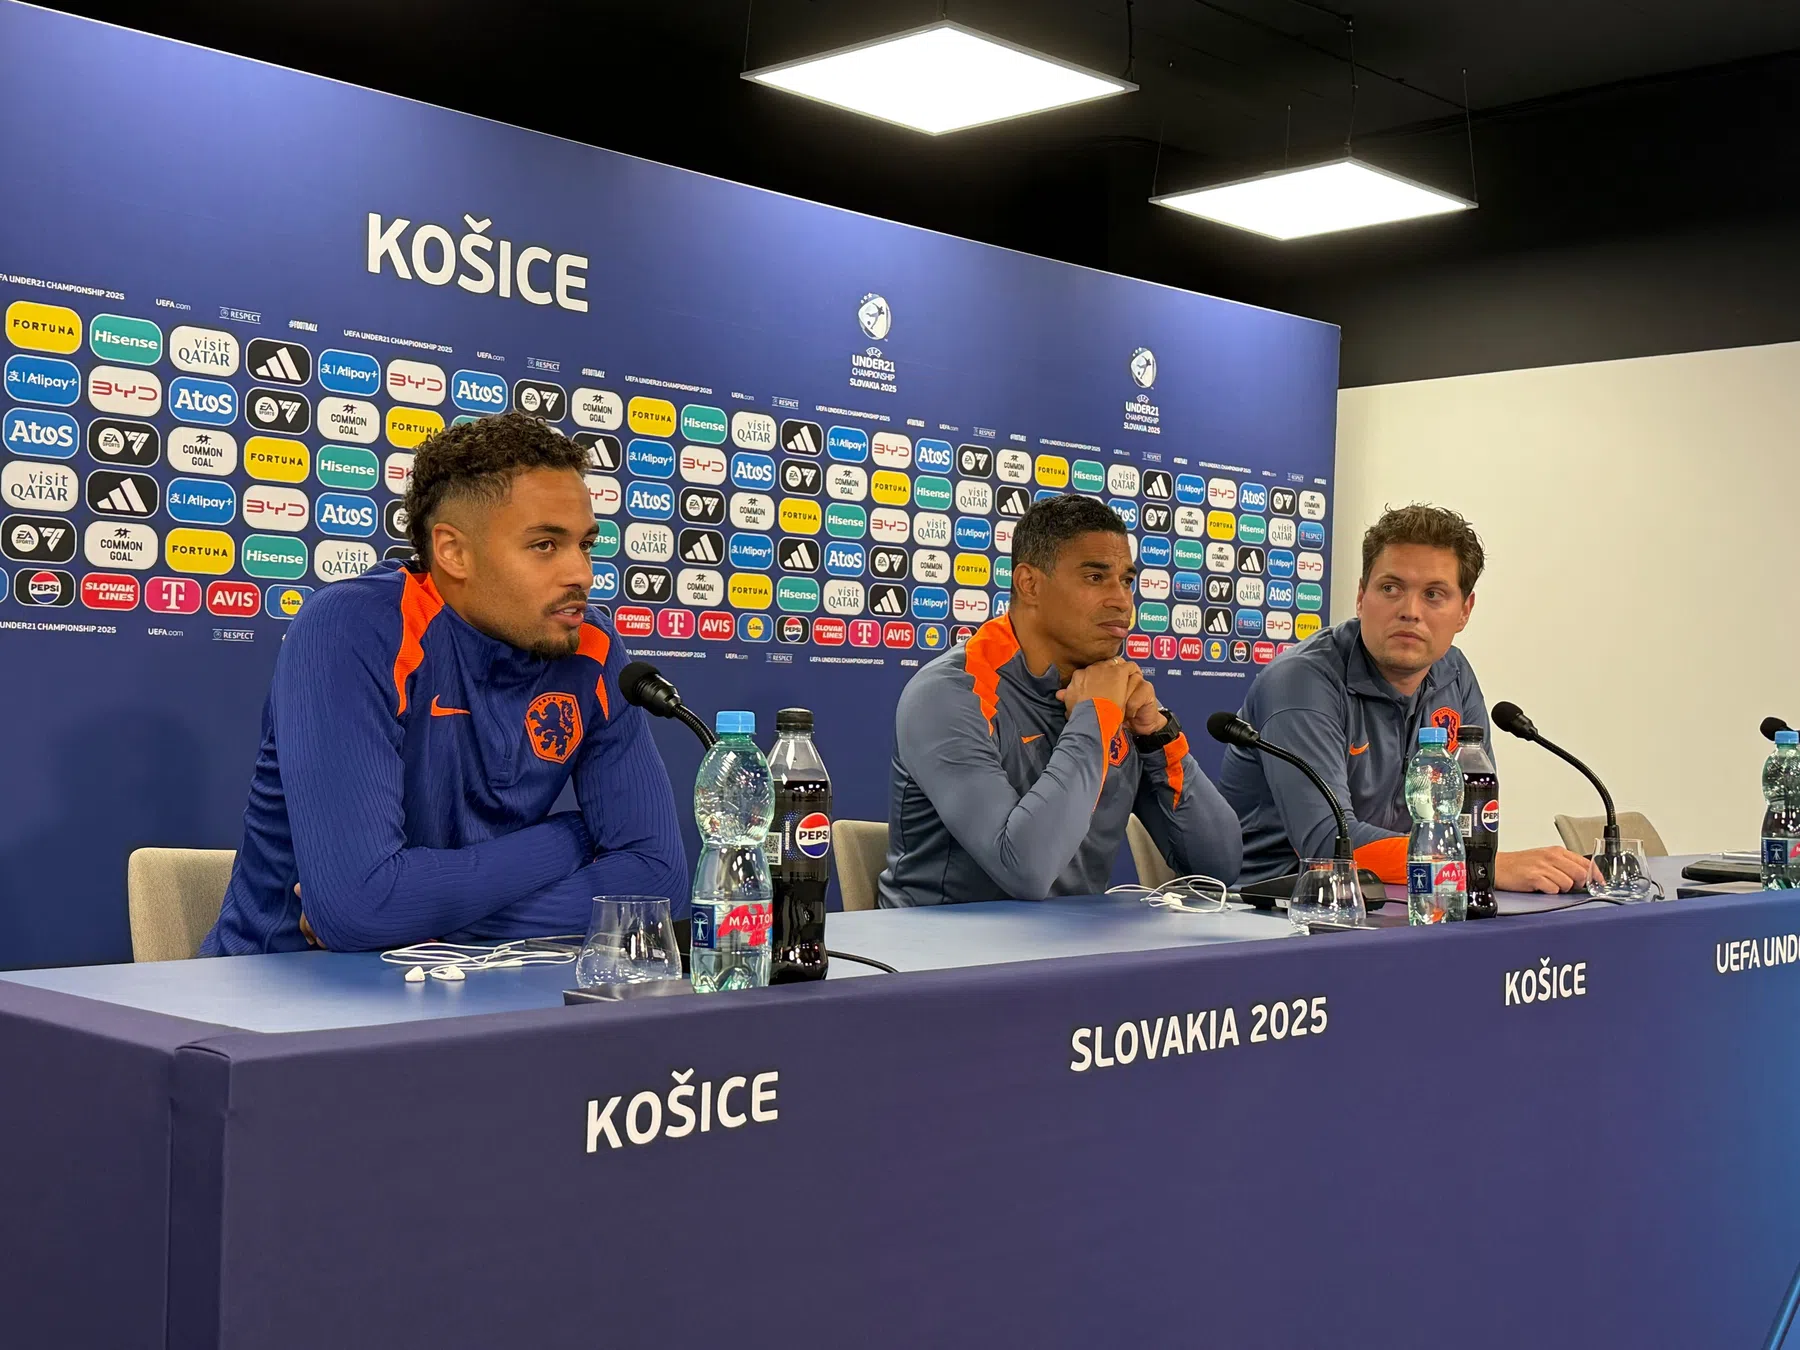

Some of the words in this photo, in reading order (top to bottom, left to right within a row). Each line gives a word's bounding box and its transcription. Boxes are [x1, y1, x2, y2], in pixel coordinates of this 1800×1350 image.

[367, 212, 588, 313] KOŠICE
[9, 275, 45, 288] UNDER21
[46, 281, 105, 297] CHAMPIONSHIP
[105, 289, 125, 300] 2025
[155, 298, 191, 311] UEFA.com
[230, 310, 261, 322] RESPECT
[13, 318, 75, 337] FORTUNA
[94, 330, 158, 350] Hisense
[194, 336, 231, 353] visit
[343, 329, 361, 339] UEFA
[361, 332, 390, 344] UNDER21
[390, 336, 438, 351] CHAMPIONSHIP
[437, 344, 453, 354] 2025
[178, 347, 230, 368] QATAR
[476, 351, 505, 362] UEFA.com
[535, 360, 560, 372] RESPECT
[852, 354, 896, 373] UNDER21
[852, 367, 896, 381] CHAMPIONSHIP
[389, 371, 443, 393] BYD
[849, 378, 880, 391] SLOVAKIA
[881, 383, 897, 393] 2025
[92, 380, 158, 401] BYD
[582, 403, 613, 415] COMMON
[1125, 401, 1159, 417] UNDER21
[330, 412, 367, 427] COMMON
[589, 413, 606, 424] GOAL
[632, 410, 672, 423] FORTUNA
[1125, 413, 1160, 425] CHAMPIONSHIP
[338, 424, 360, 437] GOAL
[391, 421, 439, 434] FORTUNA
[684, 416, 725, 432] Hisense
[747, 419, 772, 433] visit
[1147, 426, 1161, 435] 2025
[737, 428, 771, 444] QATAR
[182, 444, 223, 458] COMMON
[874, 443, 910, 458] BYD
[191, 456, 214, 469] GOAL
[250, 452, 304, 467] FORTUNA
[682, 457, 725, 473] BYD
[320, 459, 376, 476] Hisense
[1037, 466, 1066, 477] FORTUNA
[28, 470, 69, 487] visit
[1073, 470, 1103, 483] Hisense
[1118, 470, 1136, 481] visit
[834, 477, 860, 488] COMMON
[874, 482, 907, 493] FORTUNA
[1111, 478, 1136, 491] QATAR
[10, 482, 69, 502] QATAR
[840, 486, 854, 496] GOAL
[916, 487, 950, 500] Hisense
[968, 486, 988, 498] visit
[1209, 487, 1236, 500] BYD
[246, 499, 306, 517] BYD
[960, 495, 988, 509] QATAR
[739, 506, 766, 517] COMMON
[782, 511, 818, 522] FORTUNA
[744, 514, 760, 525] GOAL
[828, 514, 864, 528] Hisense
[872, 518, 908, 532] BYD
[926, 517, 947, 530] visit
[917, 526, 947, 540] QATAR
[1239, 523, 1265, 536] Hisense
[642, 530, 668, 543] visit
[100, 538, 143, 552] COMMON
[171, 544, 229, 558] FORTUNA
[630, 540, 668, 555] QATAR
[109, 550, 133, 563] GOAL
[246, 549, 304, 565] Hisense
[336, 548, 369, 563] visit
[1175, 548, 1202, 561] Hisense
[322, 560, 368, 576] QATAR
[920, 561, 943, 571] COMMON
[957, 564, 988, 574] FORTUNA
[925, 569, 938, 579] GOAL
[30, 583, 60, 593] PEPSI
[85, 581, 136, 593] SLOVAK
[686, 582, 715, 593] COMMON
[1140, 578, 1169, 589] BYD
[98, 591, 135, 602] LINES
[692, 591, 708, 601] GOAL
[732, 586, 769, 596] FORTUNA
[779, 588, 817, 601] Hisense
[837, 586, 860, 598] visit
[211, 590, 254, 607] AVIS
[828, 595, 860, 609] QATAR
[954, 598, 988, 612] BYD
[617, 613, 651, 623] SLOVAK
[1140, 611, 1168, 623] Hisense
[1174, 618, 1198, 629] QATAR
[0, 621, 36, 631] UNDER21
[37, 623, 97, 634] CHAMPIONSHIP
[97, 625, 117, 634] 2025
[626, 621, 651, 631] LINES
[701, 619, 731, 633] AVIS
[815, 624, 844, 633] SLOVAK
[1266, 619, 1293, 631] BYD
[148, 628, 184, 638] UEFA.com
[223, 631, 255, 641] RESPECT
[822, 631, 844, 640] LINES
[886, 628, 912, 642] AVIS
[1181, 643, 1200, 656] AVIS
[1716, 939, 1761, 974] UEFA
[1505, 956, 1587, 1006] KOŠICE
[1070, 1008, 1240, 1072] SLOVAKIA
[1251, 996, 1328, 1045] 2025
[585, 1068, 779, 1154] KOŠICE
